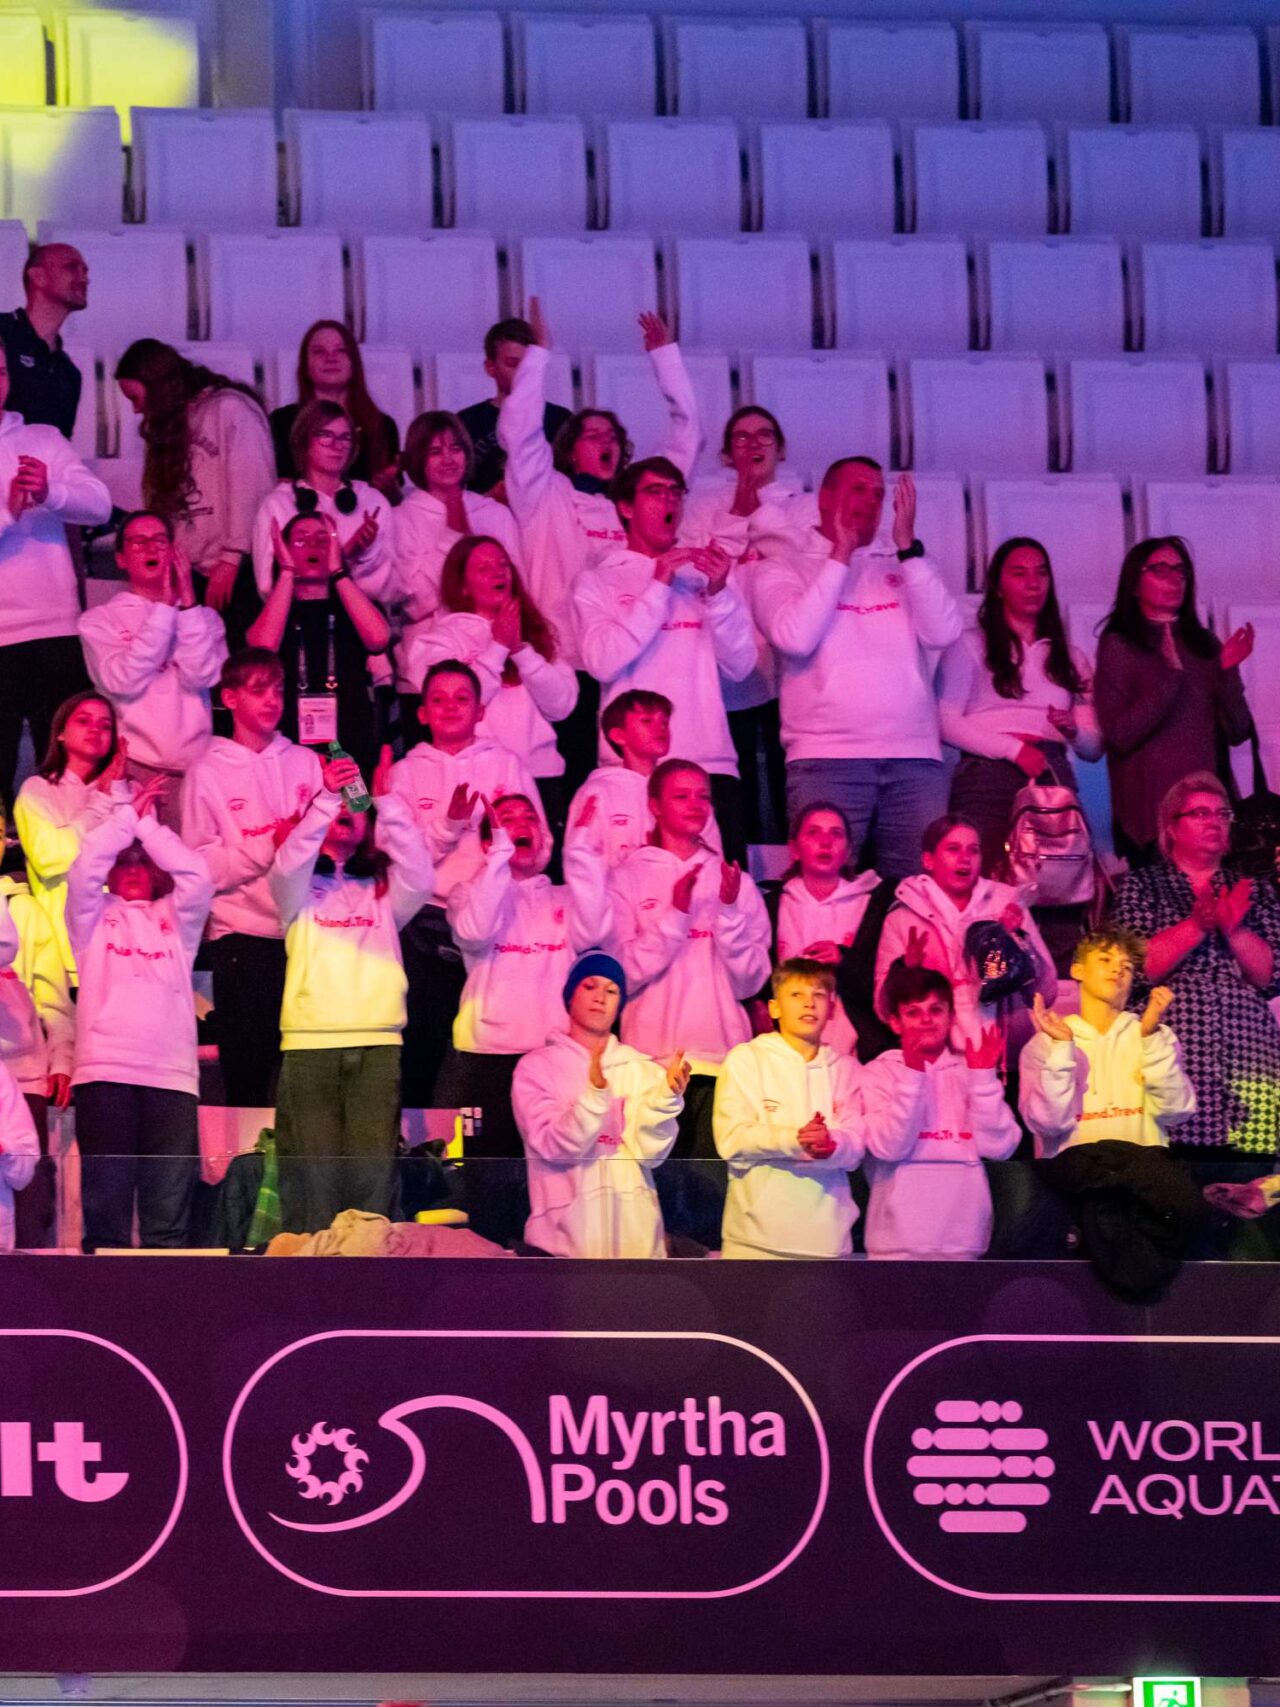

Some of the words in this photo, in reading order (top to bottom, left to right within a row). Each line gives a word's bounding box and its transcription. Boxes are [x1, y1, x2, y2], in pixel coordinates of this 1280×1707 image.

[549, 1395, 786, 1470] Myrtha
[551, 1463, 729, 1526] Pools
[1089, 1473, 1280, 1520] AQUA
